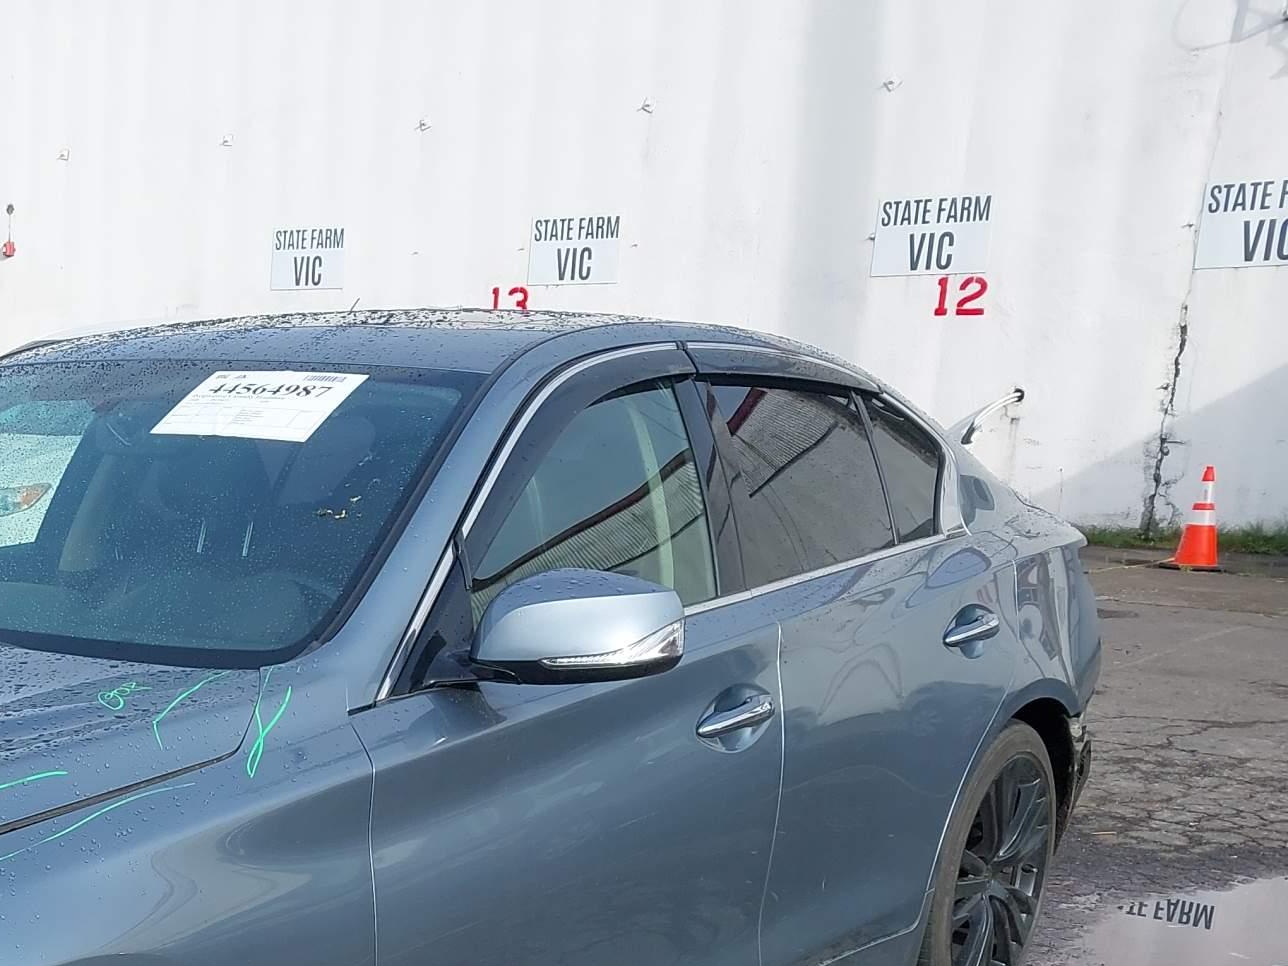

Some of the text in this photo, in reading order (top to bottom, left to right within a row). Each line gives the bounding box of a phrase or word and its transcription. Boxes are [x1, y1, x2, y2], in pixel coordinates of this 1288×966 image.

[881, 195, 992, 227] STATE FARM
[1208, 181, 1275, 214] STATE
[275, 228, 344, 250] STATE FARM
[534, 216, 620, 241] STATE FARM
[557, 246, 593, 281] VIC
[909, 231, 955, 271] VIC
[294, 255, 322, 286] VIC
[934, 276, 988, 316] 12
[209, 382, 336, 399] 44564987
